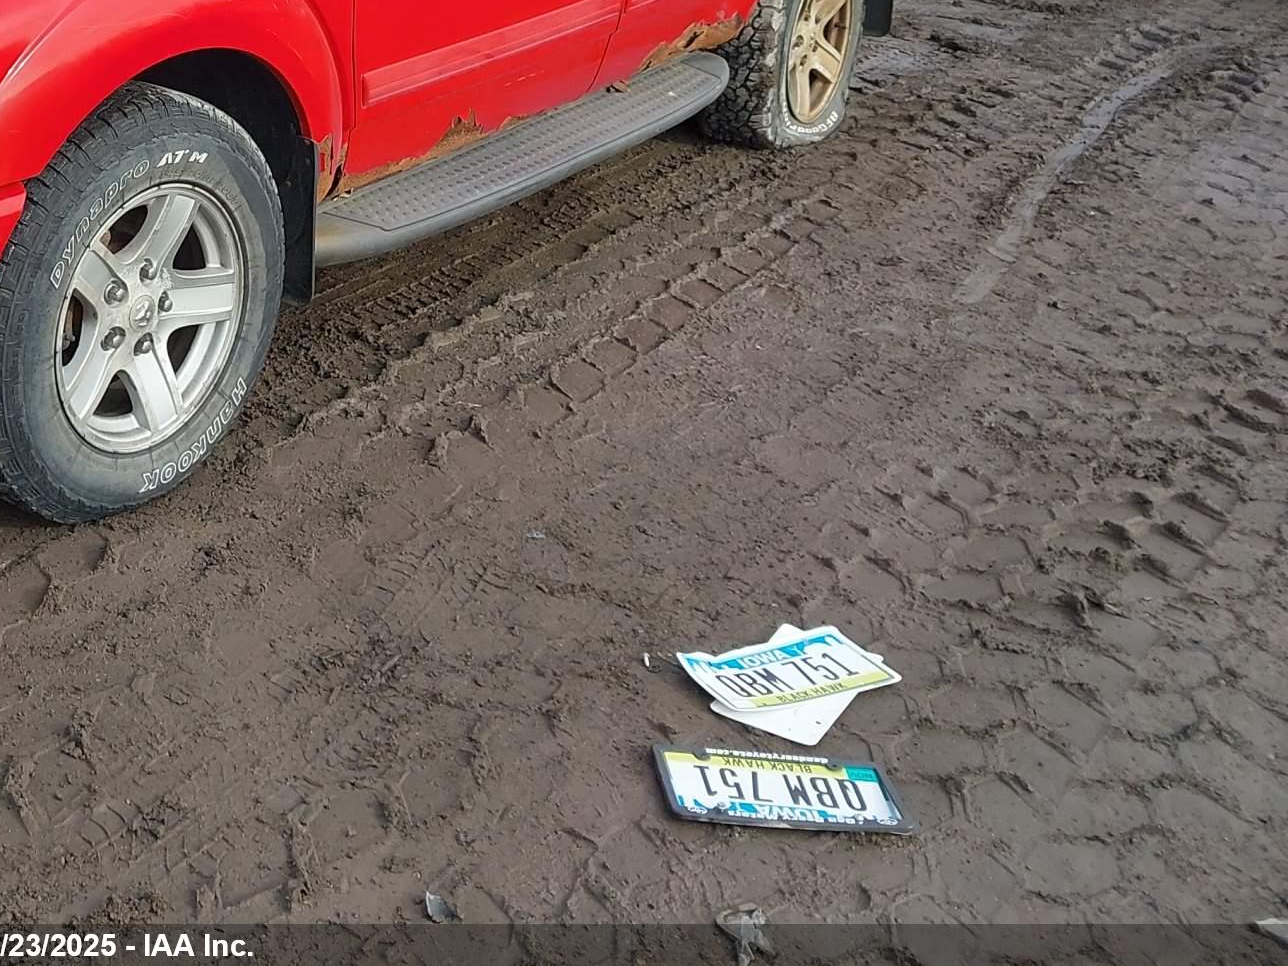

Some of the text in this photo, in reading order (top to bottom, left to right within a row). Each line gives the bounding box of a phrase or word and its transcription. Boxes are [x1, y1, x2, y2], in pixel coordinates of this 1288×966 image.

[49, 159, 150, 290] Dynapro
[137, 376, 248, 494] Hankook
[715, 652, 861, 698] QBM 751
[737, 648, 789, 670] IOWA
[775, 682, 849, 703] BLACK HAWK
[693, 764, 868, 812] QBM 751
[721, 756, 813, 774] BLACK HAWK
